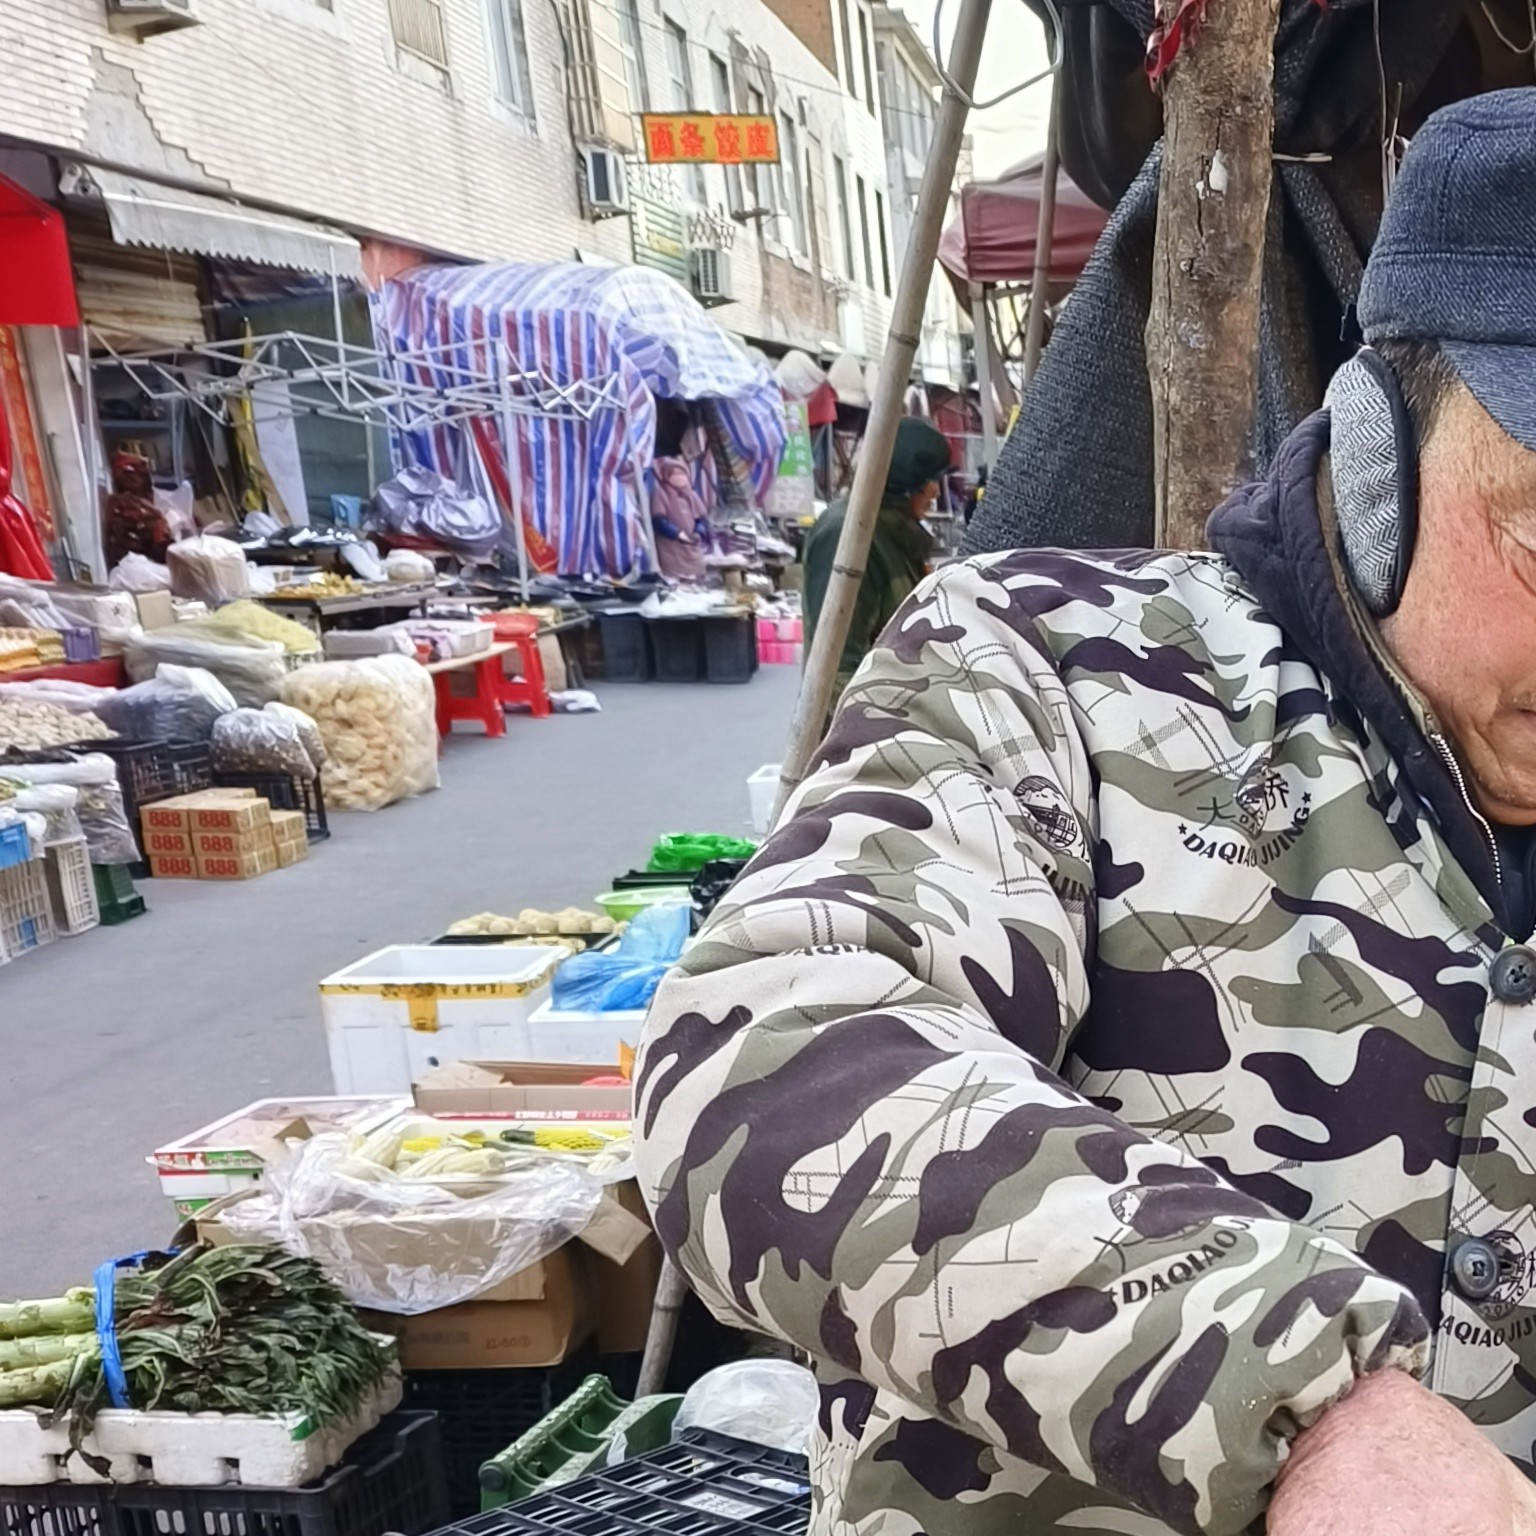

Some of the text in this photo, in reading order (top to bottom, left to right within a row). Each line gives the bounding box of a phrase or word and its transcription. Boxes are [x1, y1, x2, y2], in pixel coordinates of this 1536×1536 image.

[149, 810, 182, 828] 888
[198, 810, 231, 828] 888
[151, 835, 184, 851] 888
[201, 835, 233, 852] 888
[1182, 833, 1258, 868] DAQIAO
[1260, 806, 1310, 866] JIJING
[158, 857, 192, 875] 888
[204, 858, 238, 876] 888
[1121, 1229, 1238, 1305] DAQIAO
[1439, 1314, 1506, 1348] AQIAO
